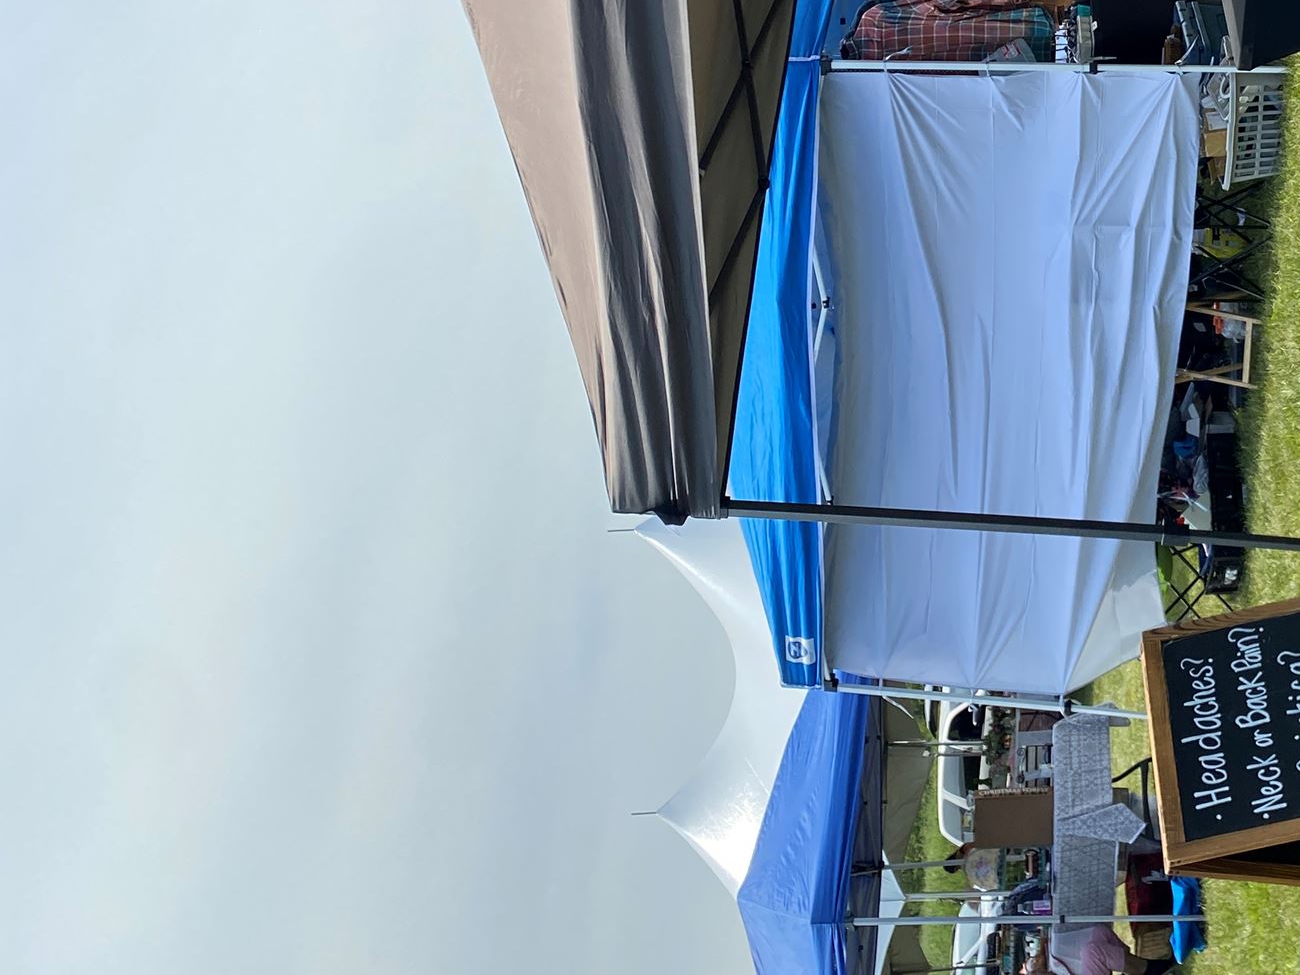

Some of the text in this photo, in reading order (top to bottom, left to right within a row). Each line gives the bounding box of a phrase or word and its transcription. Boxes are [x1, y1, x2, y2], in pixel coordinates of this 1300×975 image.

[1181, 659, 1231, 809] Headaches?
[1228, 628, 1287, 812] Neck or Back Pain?
